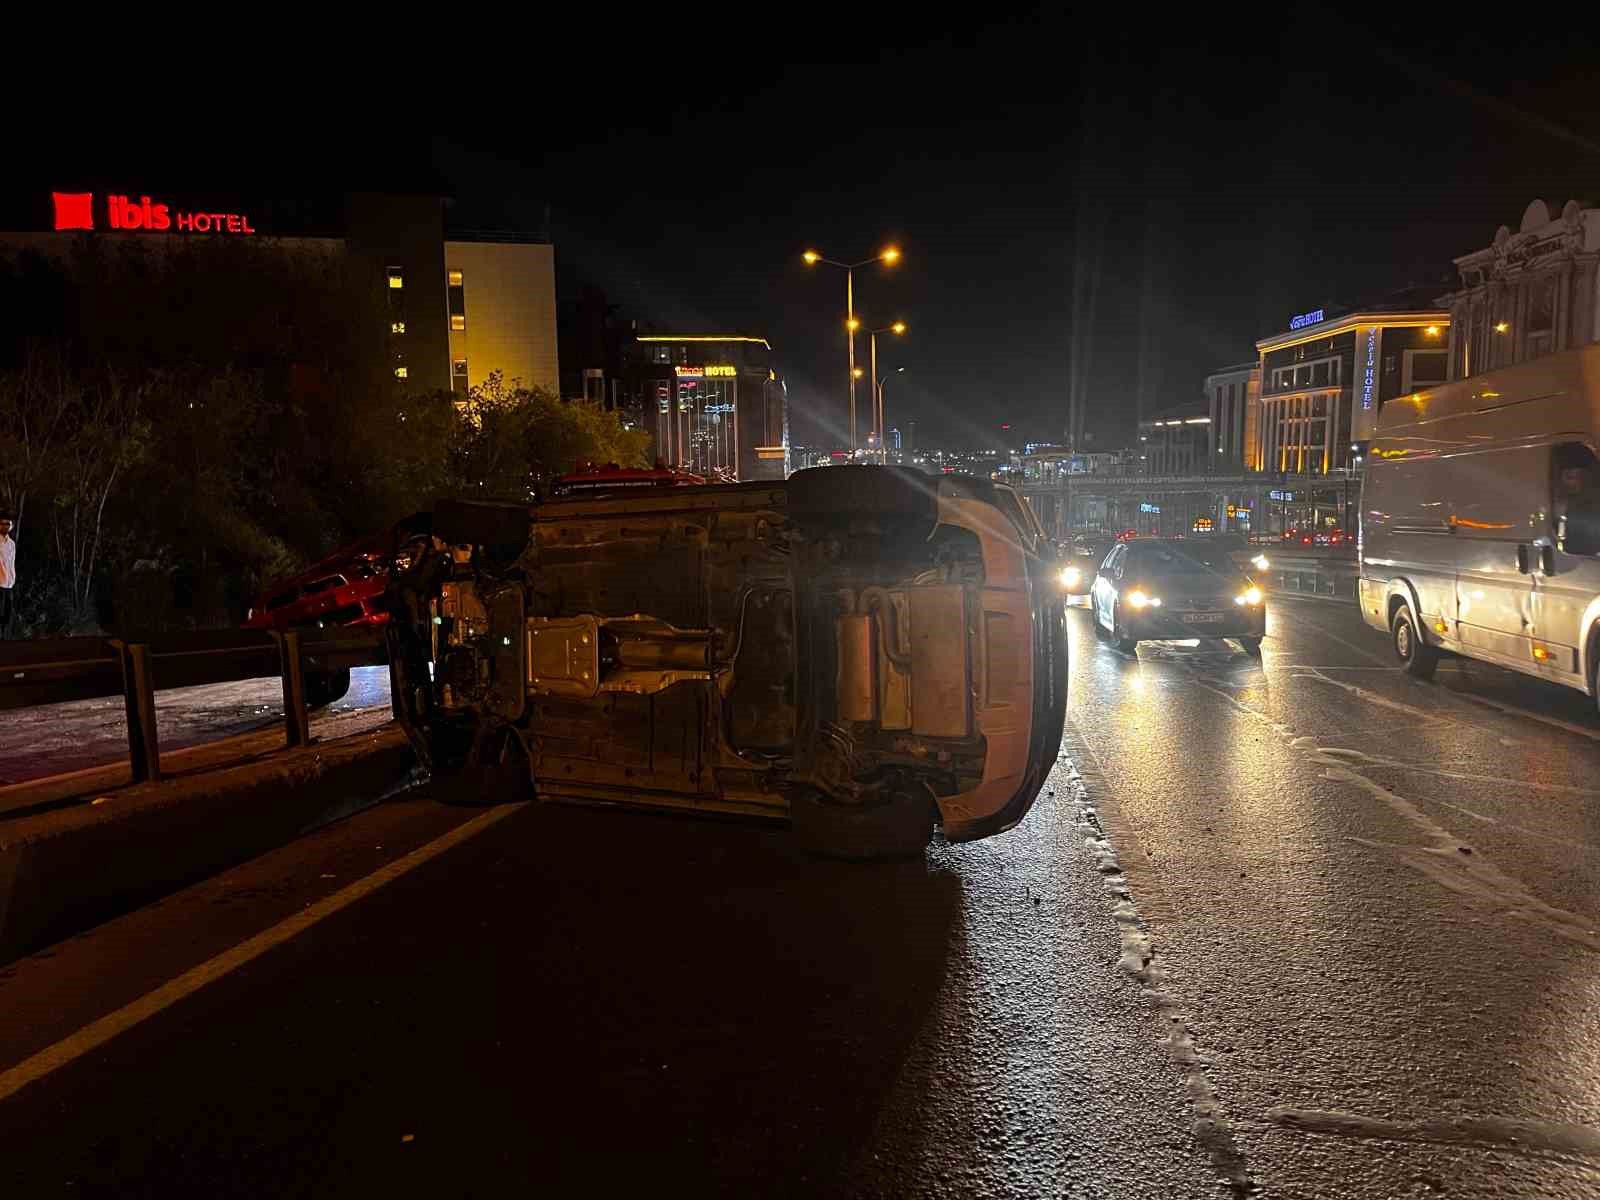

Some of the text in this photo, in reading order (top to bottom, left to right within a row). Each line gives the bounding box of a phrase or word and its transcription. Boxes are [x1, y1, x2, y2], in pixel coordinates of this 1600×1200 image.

[107, 195, 255, 233] ibis HOTEL
[705, 366, 737, 376] HOTEL
[1363, 369, 1374, 409] HOTEL
